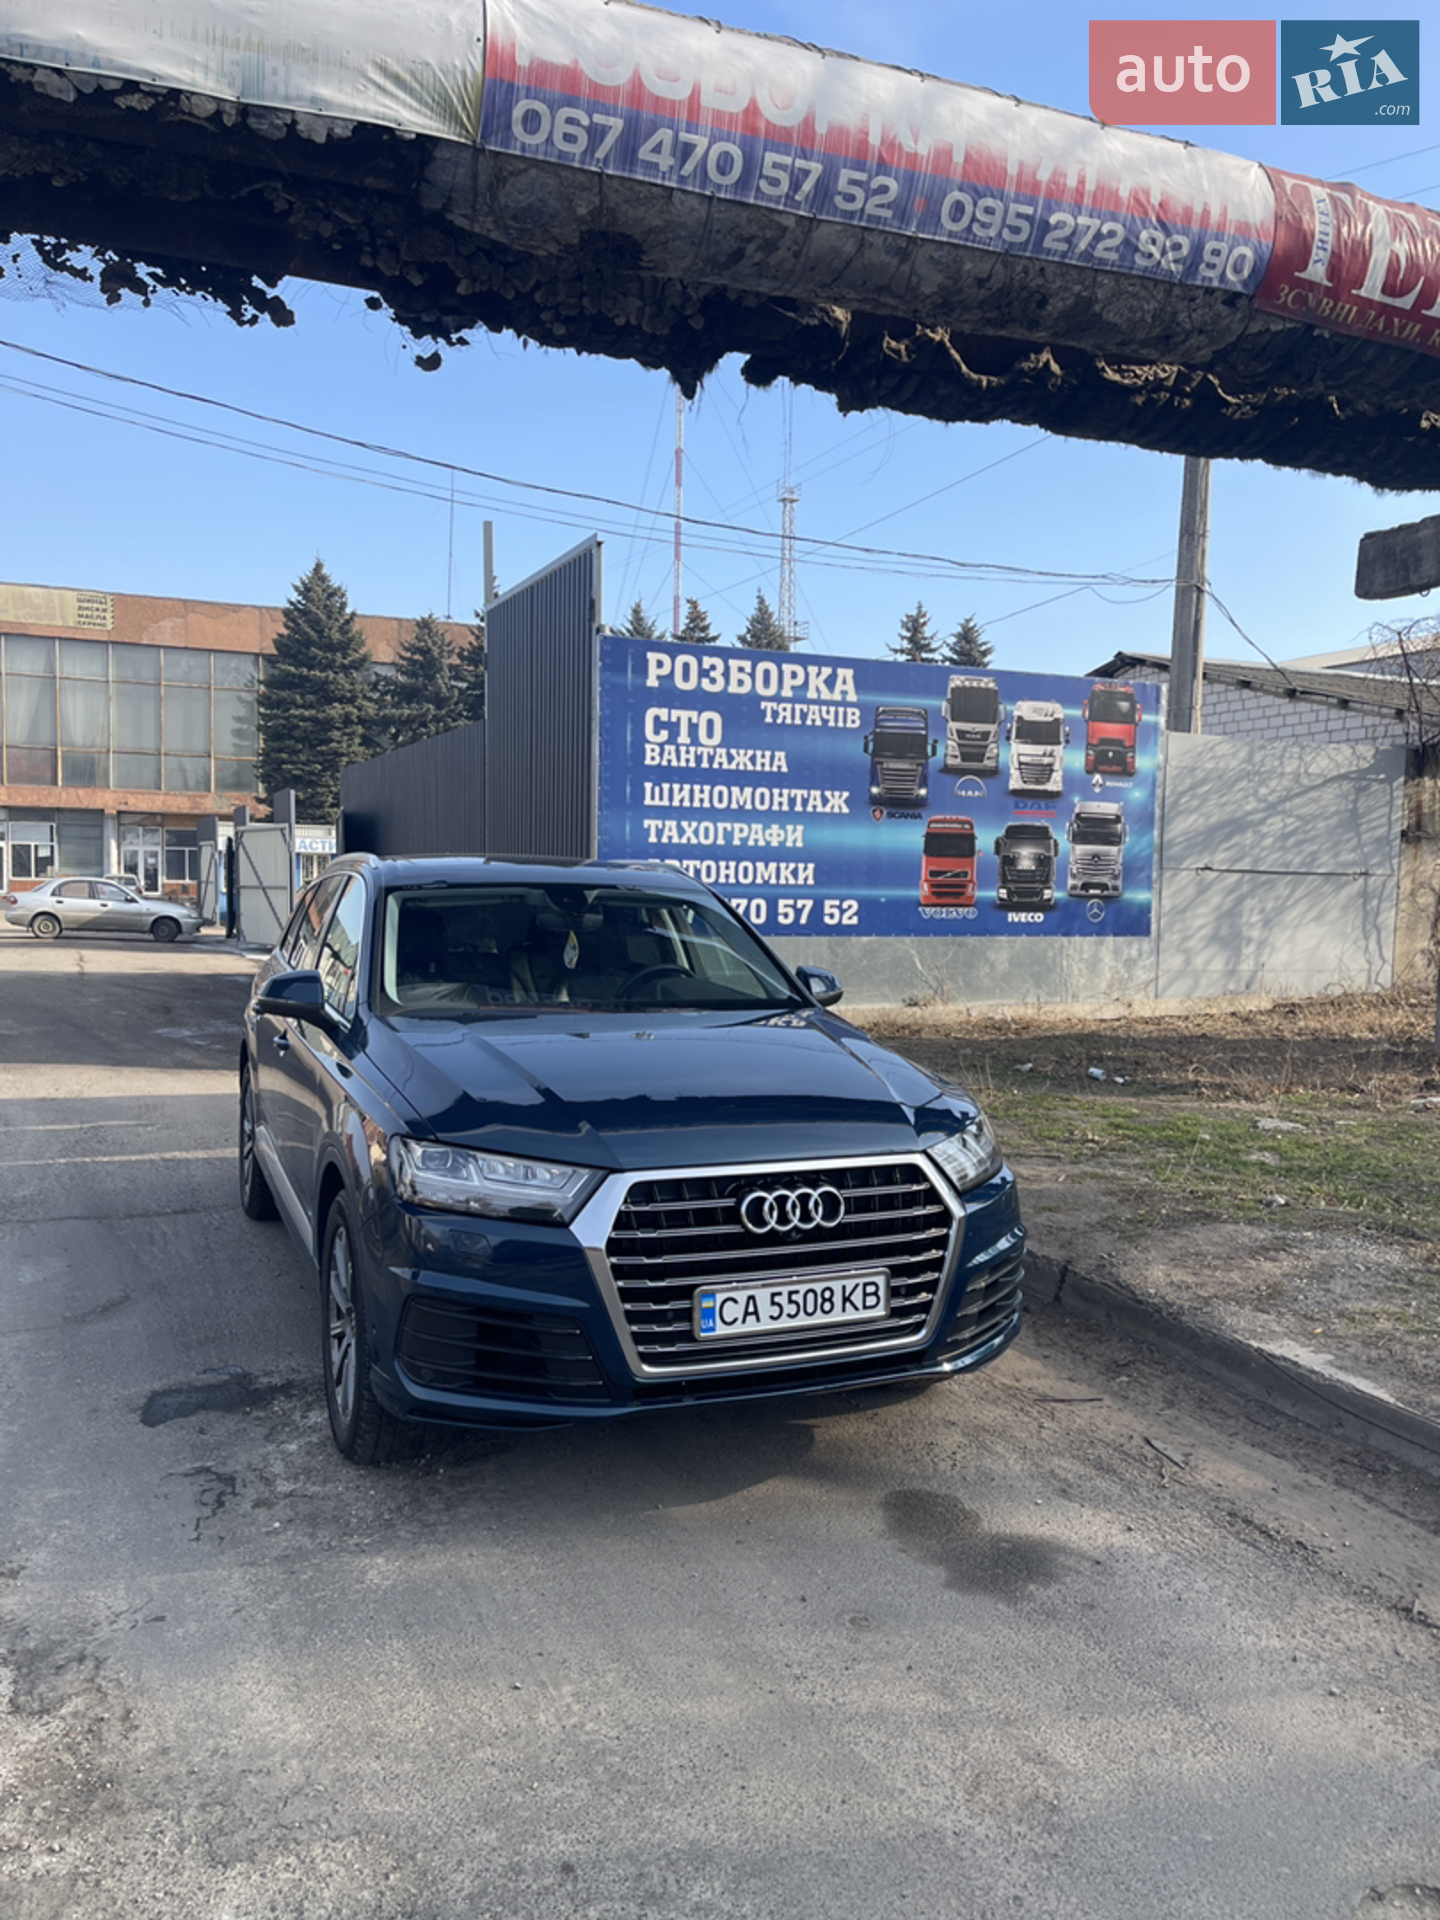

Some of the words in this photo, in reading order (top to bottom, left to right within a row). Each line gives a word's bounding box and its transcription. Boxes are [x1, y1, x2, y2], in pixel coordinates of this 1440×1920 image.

[511, 99, 624, 159] 067
[638, 127, 743, 185] 470
[758, 151, 823, 201] 57
[833, 168, 899, 218] 52
[940, 191, 1033, 243] 095
[1043, 212, 1125, 260] 272
[1134, 229, 1190, 272] 92
[1199, 241, 1255, 282] 90
[1281, 175, 1440, 320] ТЕ
[646, 651, 858, 702] РОЗБОРКА
[644, 707, 722, 746] СТО
[761, 701, 861, 728] ТЯГАЧІВ
[644, 743, 788, 772] ВАНТАЖНА
[643, 782, 850, 813] ШИНОМОНТАЖ
[1014, 800, 1057, 810] DAF
[886, 810, 923, 820] SCANIA
[643, 819, 804, 847] ТАХОГРАФИ
[648, 858, 816, 886] ТОНОМКИ
[729, 898, 768, 925] 70
[777, 899, 813, 925] 57
[823, 899, 859, 925] 52
[918, 906, 978, 920] VOLVO
[1007, 912, 1044, 923] IVECO
[718, 1295, 761, 1327] CA
[768, 1286, 835, 1321] 5508
[841, 1281, 881, 1313] KB
[700, 1319, 715, 1329] UA
